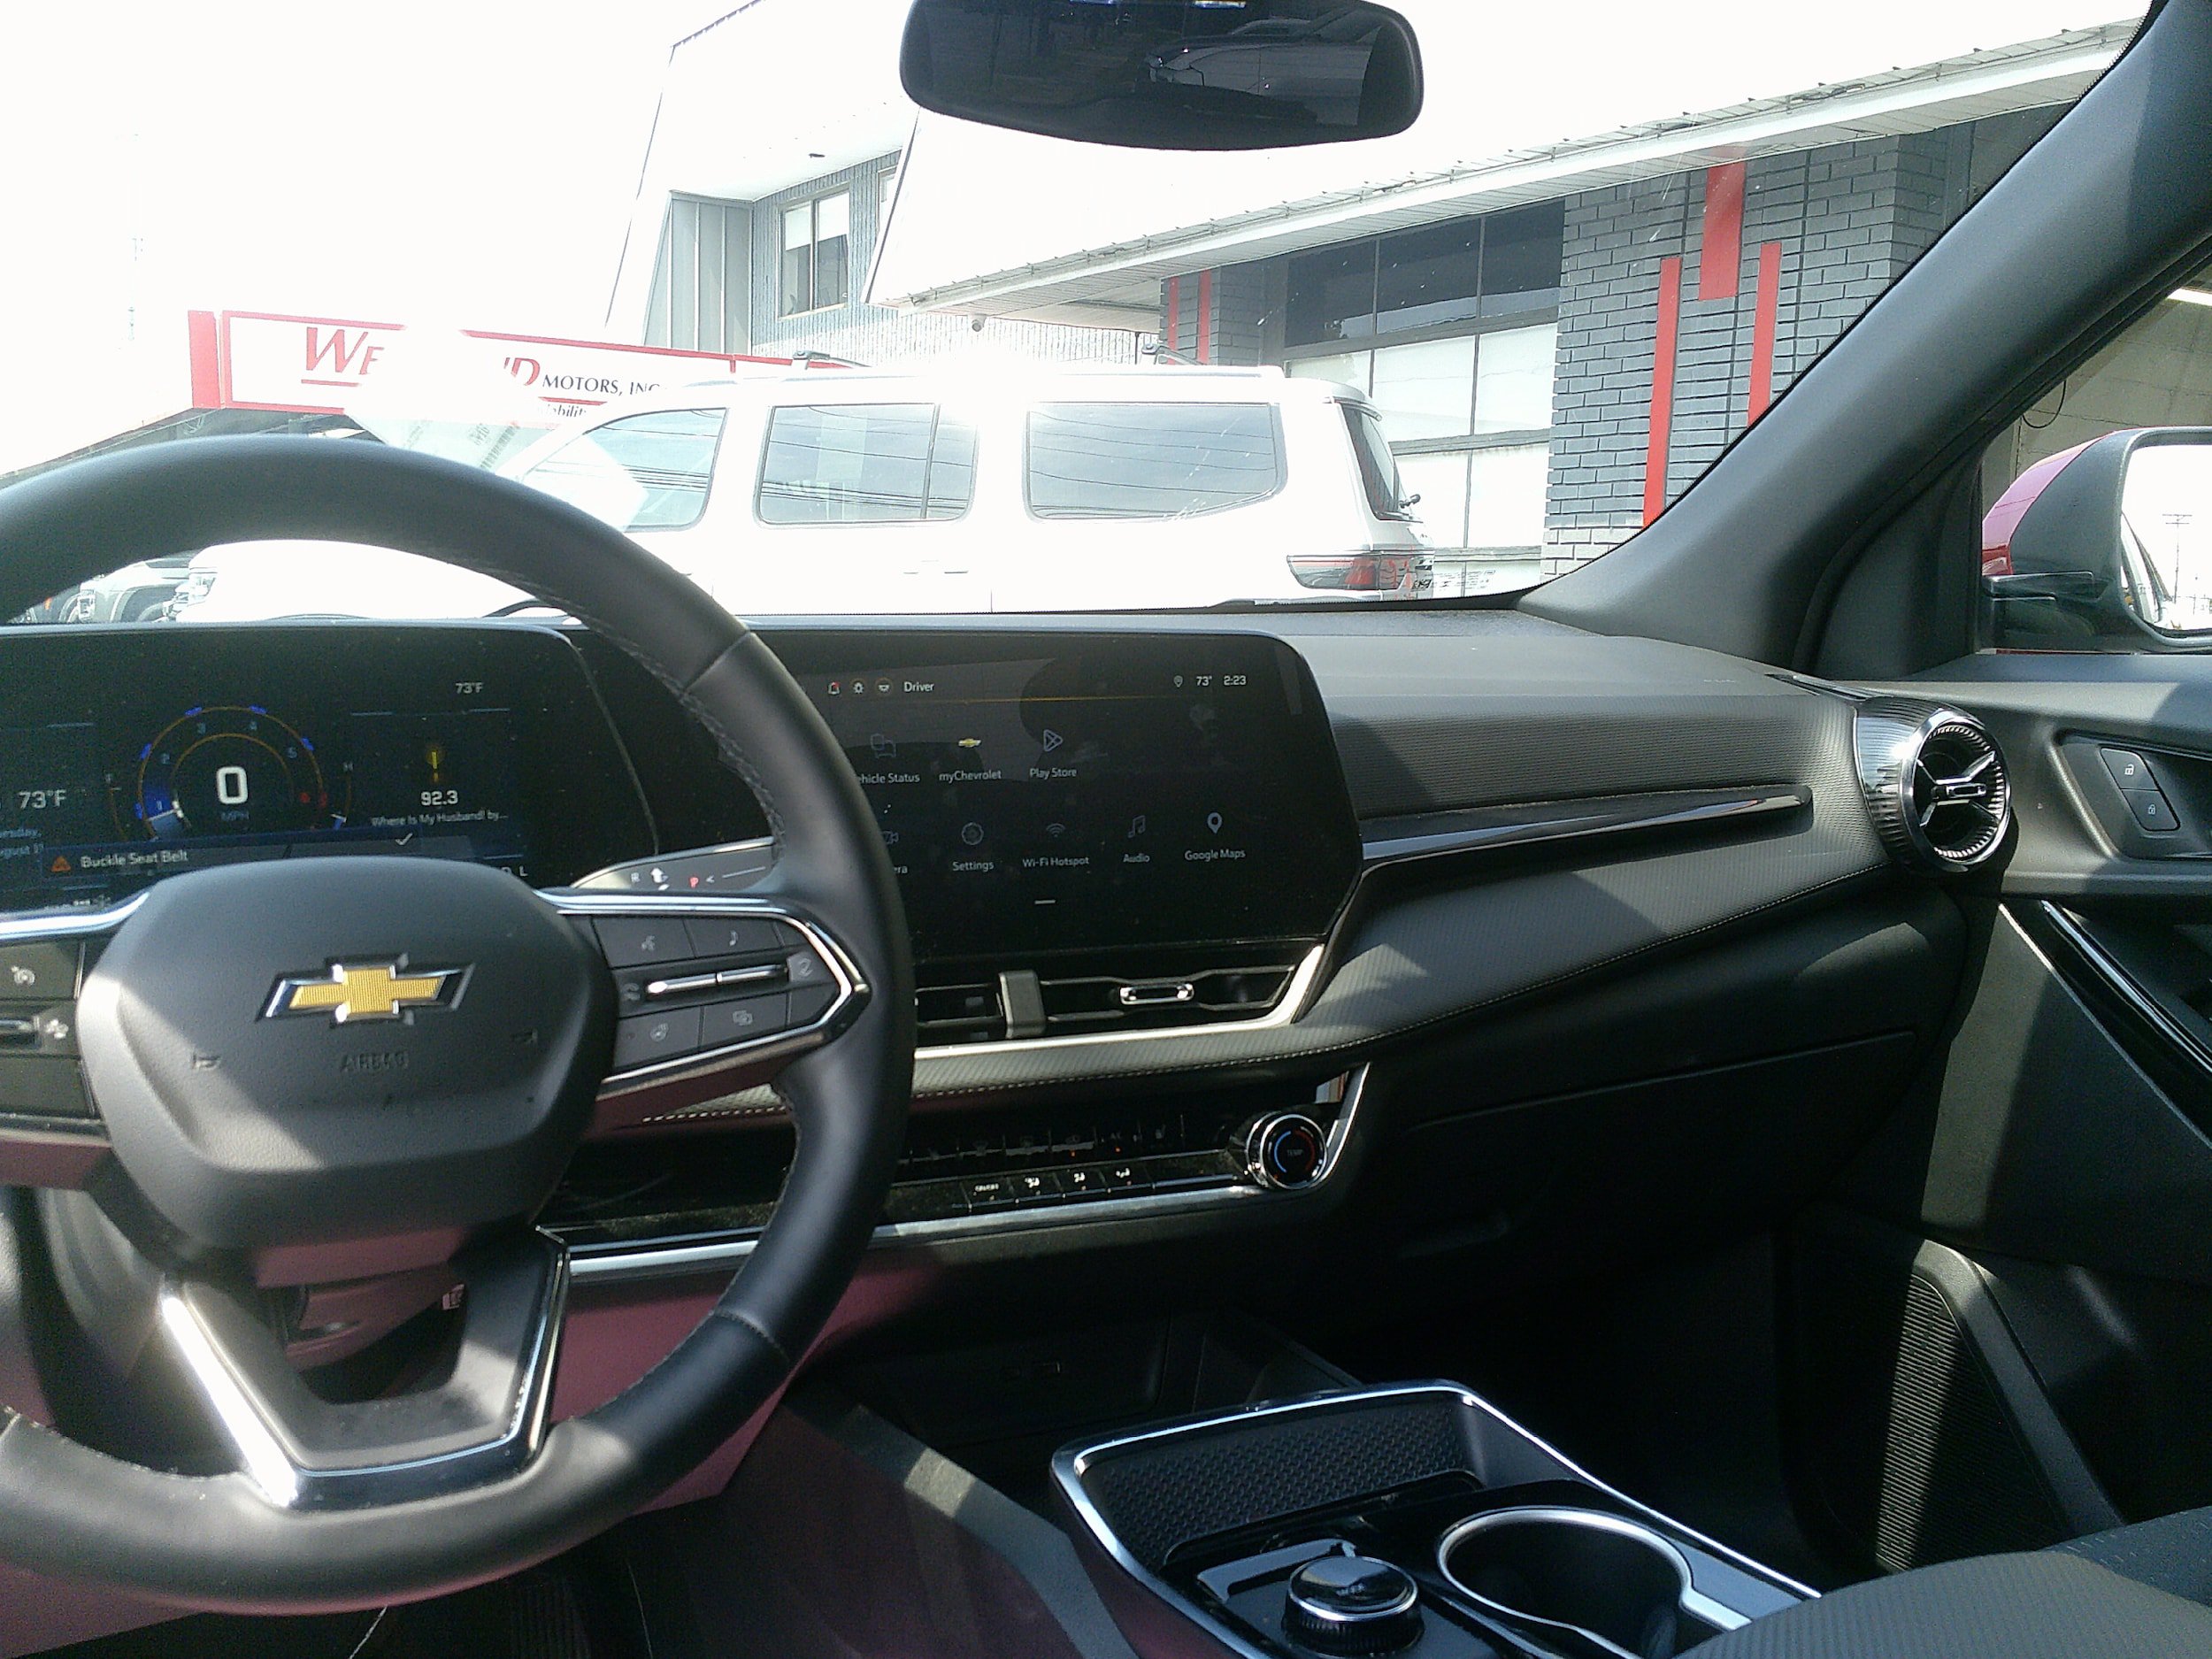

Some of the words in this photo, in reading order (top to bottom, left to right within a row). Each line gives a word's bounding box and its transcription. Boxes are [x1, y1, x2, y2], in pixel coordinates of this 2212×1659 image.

[542, 374, 623, 396] MOTORS,
[903, 681, 934, 693] Driver
[1224, 675, 1247, 686] 2:23
[455, 681, 484, 694] 73°F
[858, 772, 885, 784] ehicle
[887, 772, 921, 784] Status
[939, 769, 1002, 784] myChevrolet
[1029, 767, 1049, 780] Play
[1051, 767, 1078, 778] Store
[216, 765, 249, 804] 0
[18, 788, 67, 810] 73°F
[420, 790, 458, 806] 92.3
[371, 816, 405, 827] Where
[419, 813, 434, 826] My
[81, 856, 126, 869] Buckle
[129, 853, 157, 865] Seat
[161, 849, 188, 863] Belt
[1123, 853, 1150, 863] Audio
[1185, 849, 1218, 862] Google
[1220, 849, 1246, 859] Maps
[953, 862, 995, 872] Settings
[1023, 857, 1048, 868] Wi-Fi
[1051, 857, 1089, 867] Hotspot
[689, 876, 699, 888] P
